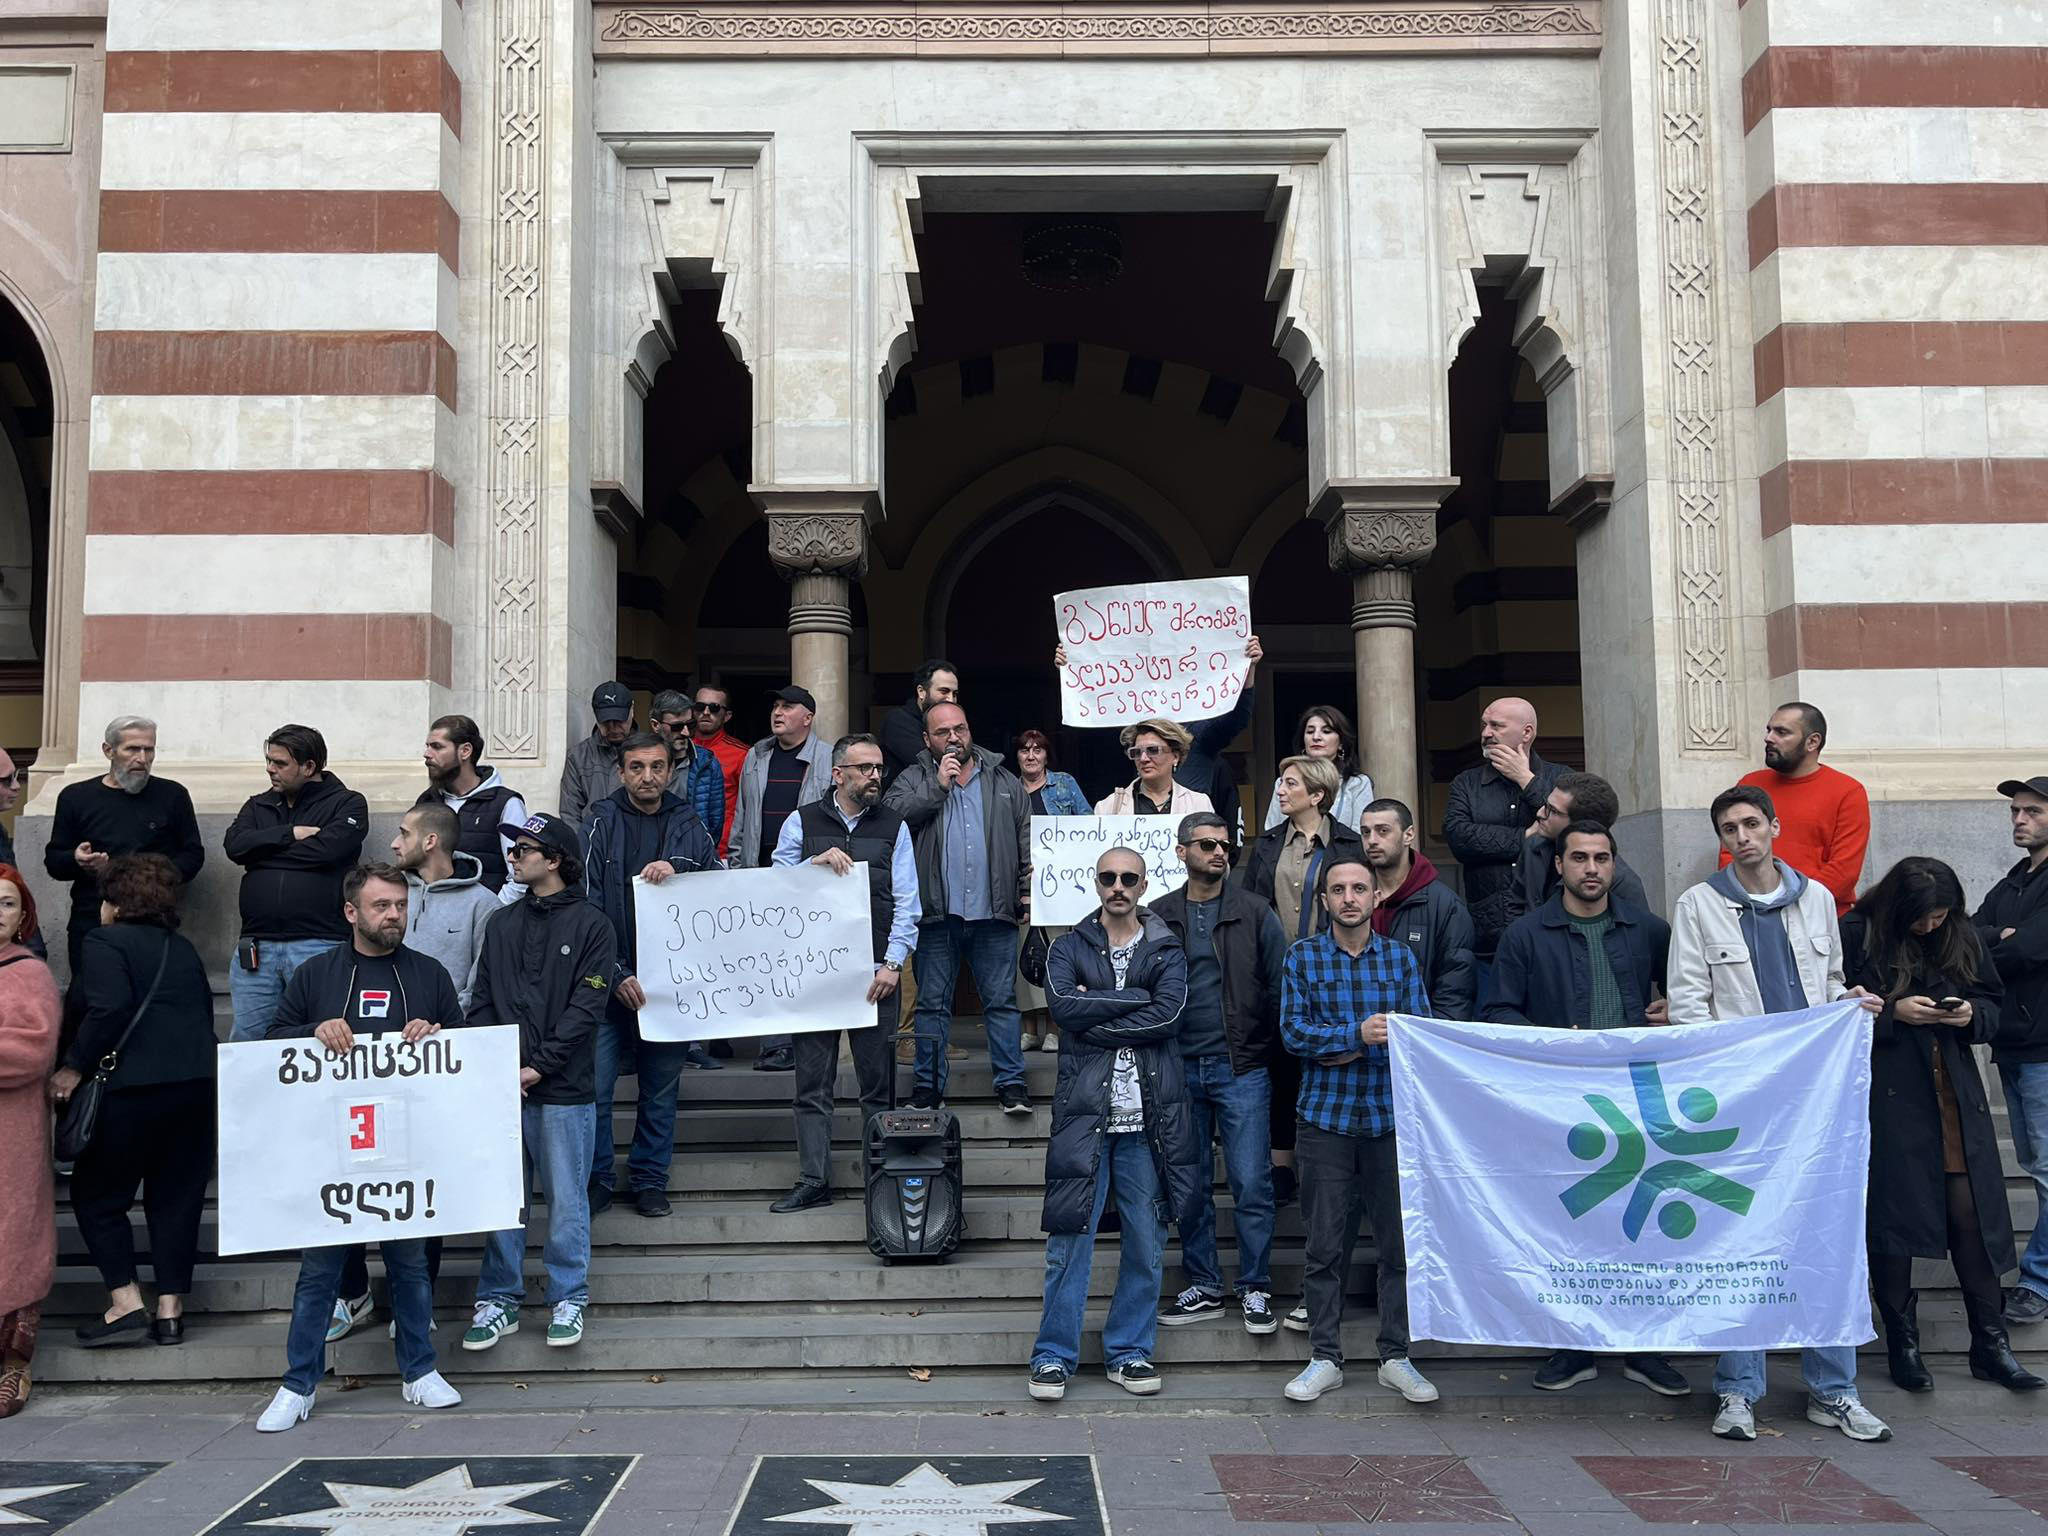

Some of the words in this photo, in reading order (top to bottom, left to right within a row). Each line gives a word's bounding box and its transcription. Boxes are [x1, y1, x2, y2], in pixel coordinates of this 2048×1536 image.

[665, 900, 832, 951] ვითხოვთ
[278, 1038, 462, 1085] გაფიცვის
[349, 1103, 376, 1150] 3
[1550, 1261, 1669, 1274] საქართველოს
[1675, 1260, 1789, 1274] მეცნიერების
[1537, 1292, 1604, 1305] მუშაკთა
[1609, 1294, 1722, 1306] პროფესიული
[1728, 1291, 1798, 1305] კავშირი
[1551, 1278, 1663, 1290] განათლებისა
[1669, 1278, 1689, 1290] და
[1695, 1276, 1785, 1290] კულტურის
